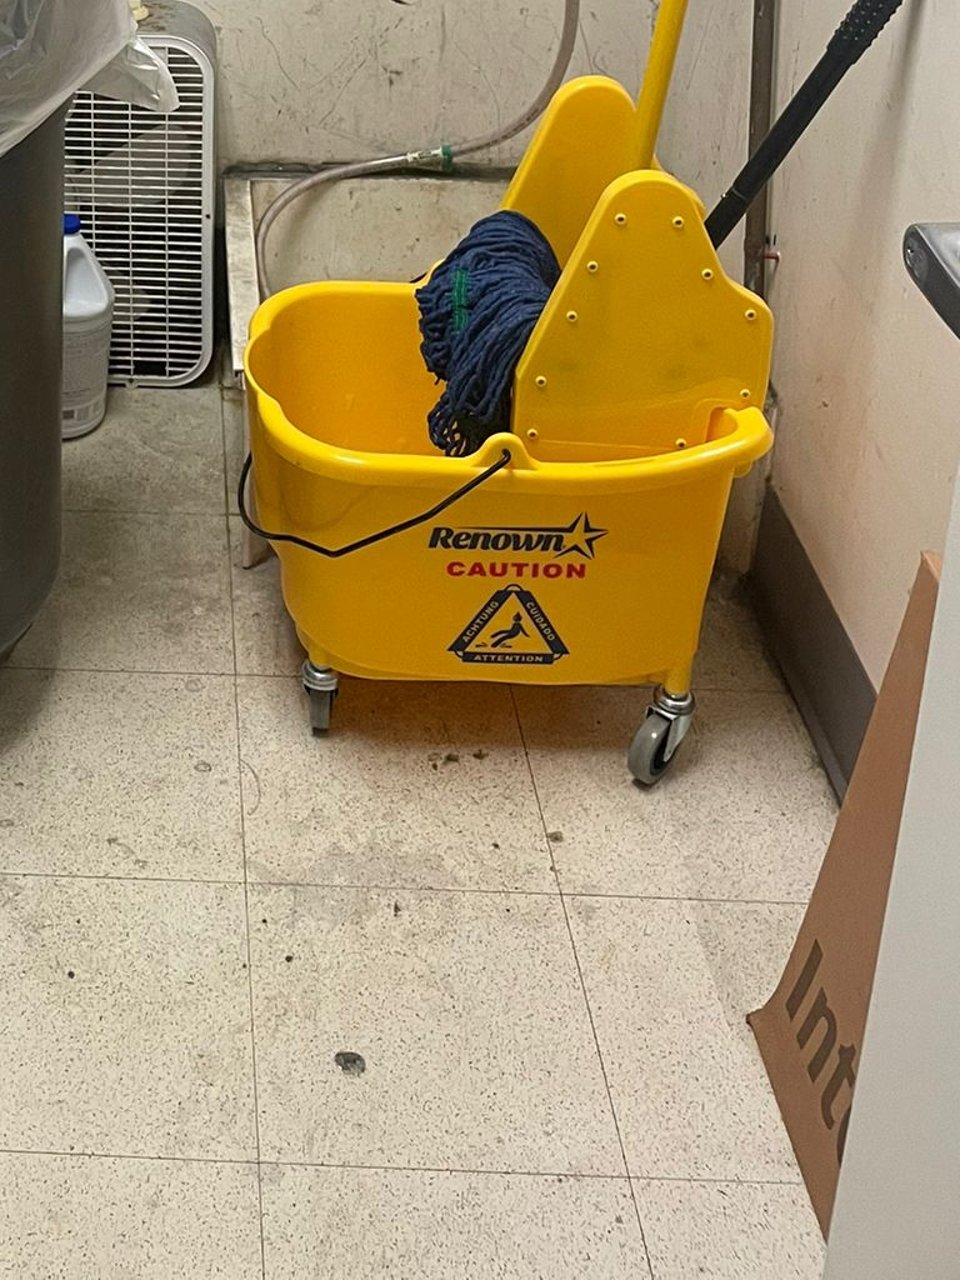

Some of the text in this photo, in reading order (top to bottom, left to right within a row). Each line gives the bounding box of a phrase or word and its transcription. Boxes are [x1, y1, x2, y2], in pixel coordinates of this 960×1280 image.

[428, 527, 564, 552] Renown
[446, 561, 587, 579] CAUTION
[461, 601, 500, 643] ACHTUNG
[525, 601, 556, 642] CUIDADO
[474, 654, 544, 663] ATTENTION
[785, 939, 857, 1168] Int
